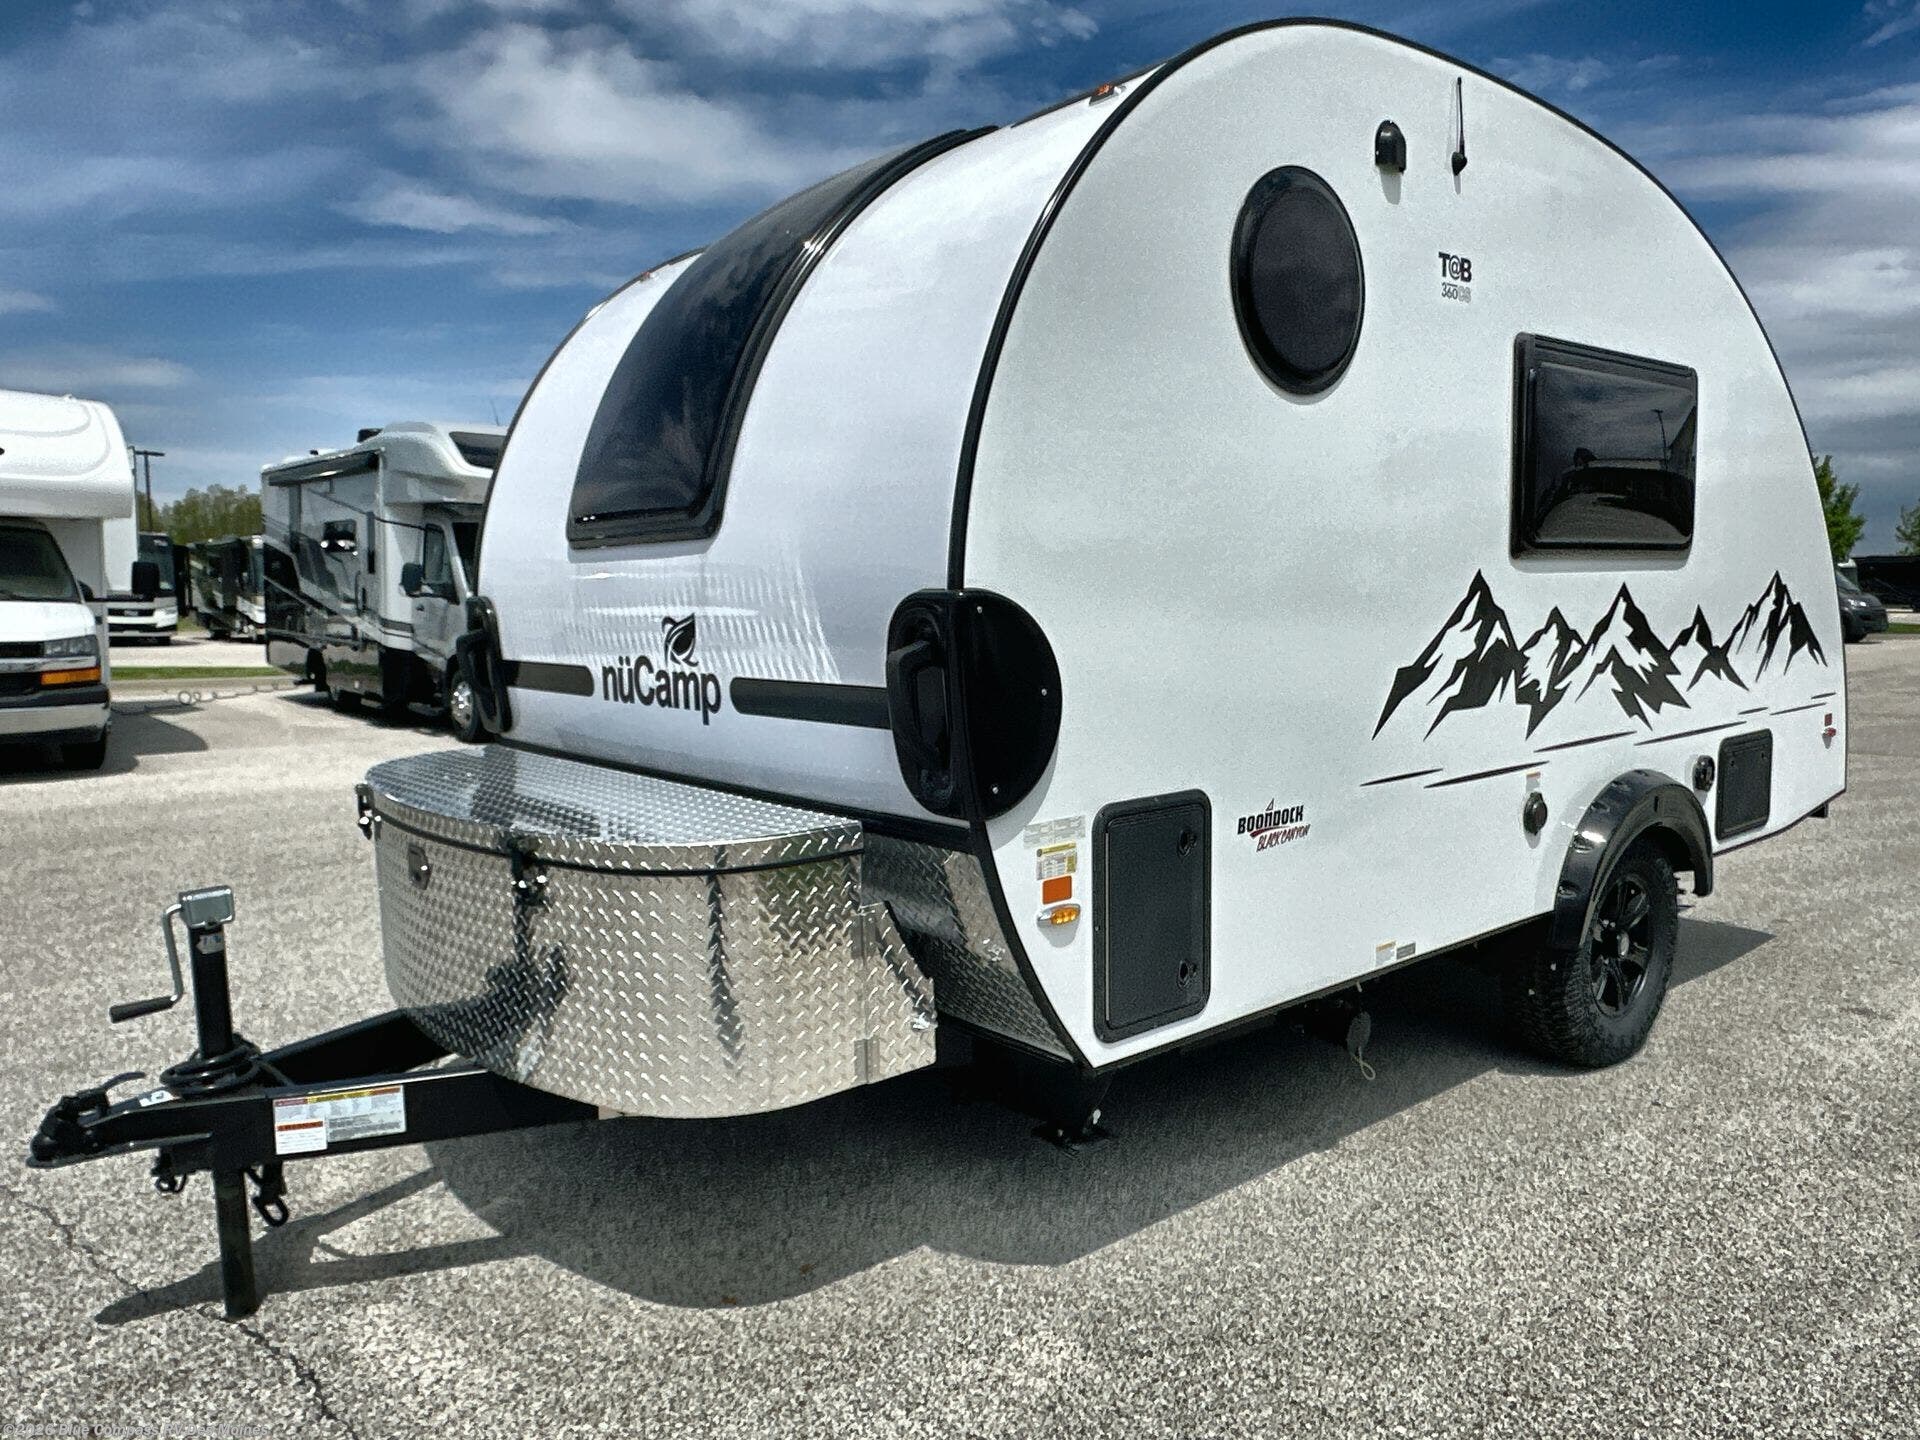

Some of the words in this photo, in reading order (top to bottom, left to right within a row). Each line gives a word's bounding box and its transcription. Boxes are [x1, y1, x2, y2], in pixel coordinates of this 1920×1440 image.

[1438, 251, 1472, 283] T@B
[602, 655, 722, 726] nüCamp
[1237, 805, 1304, 835] BOONDOCK
